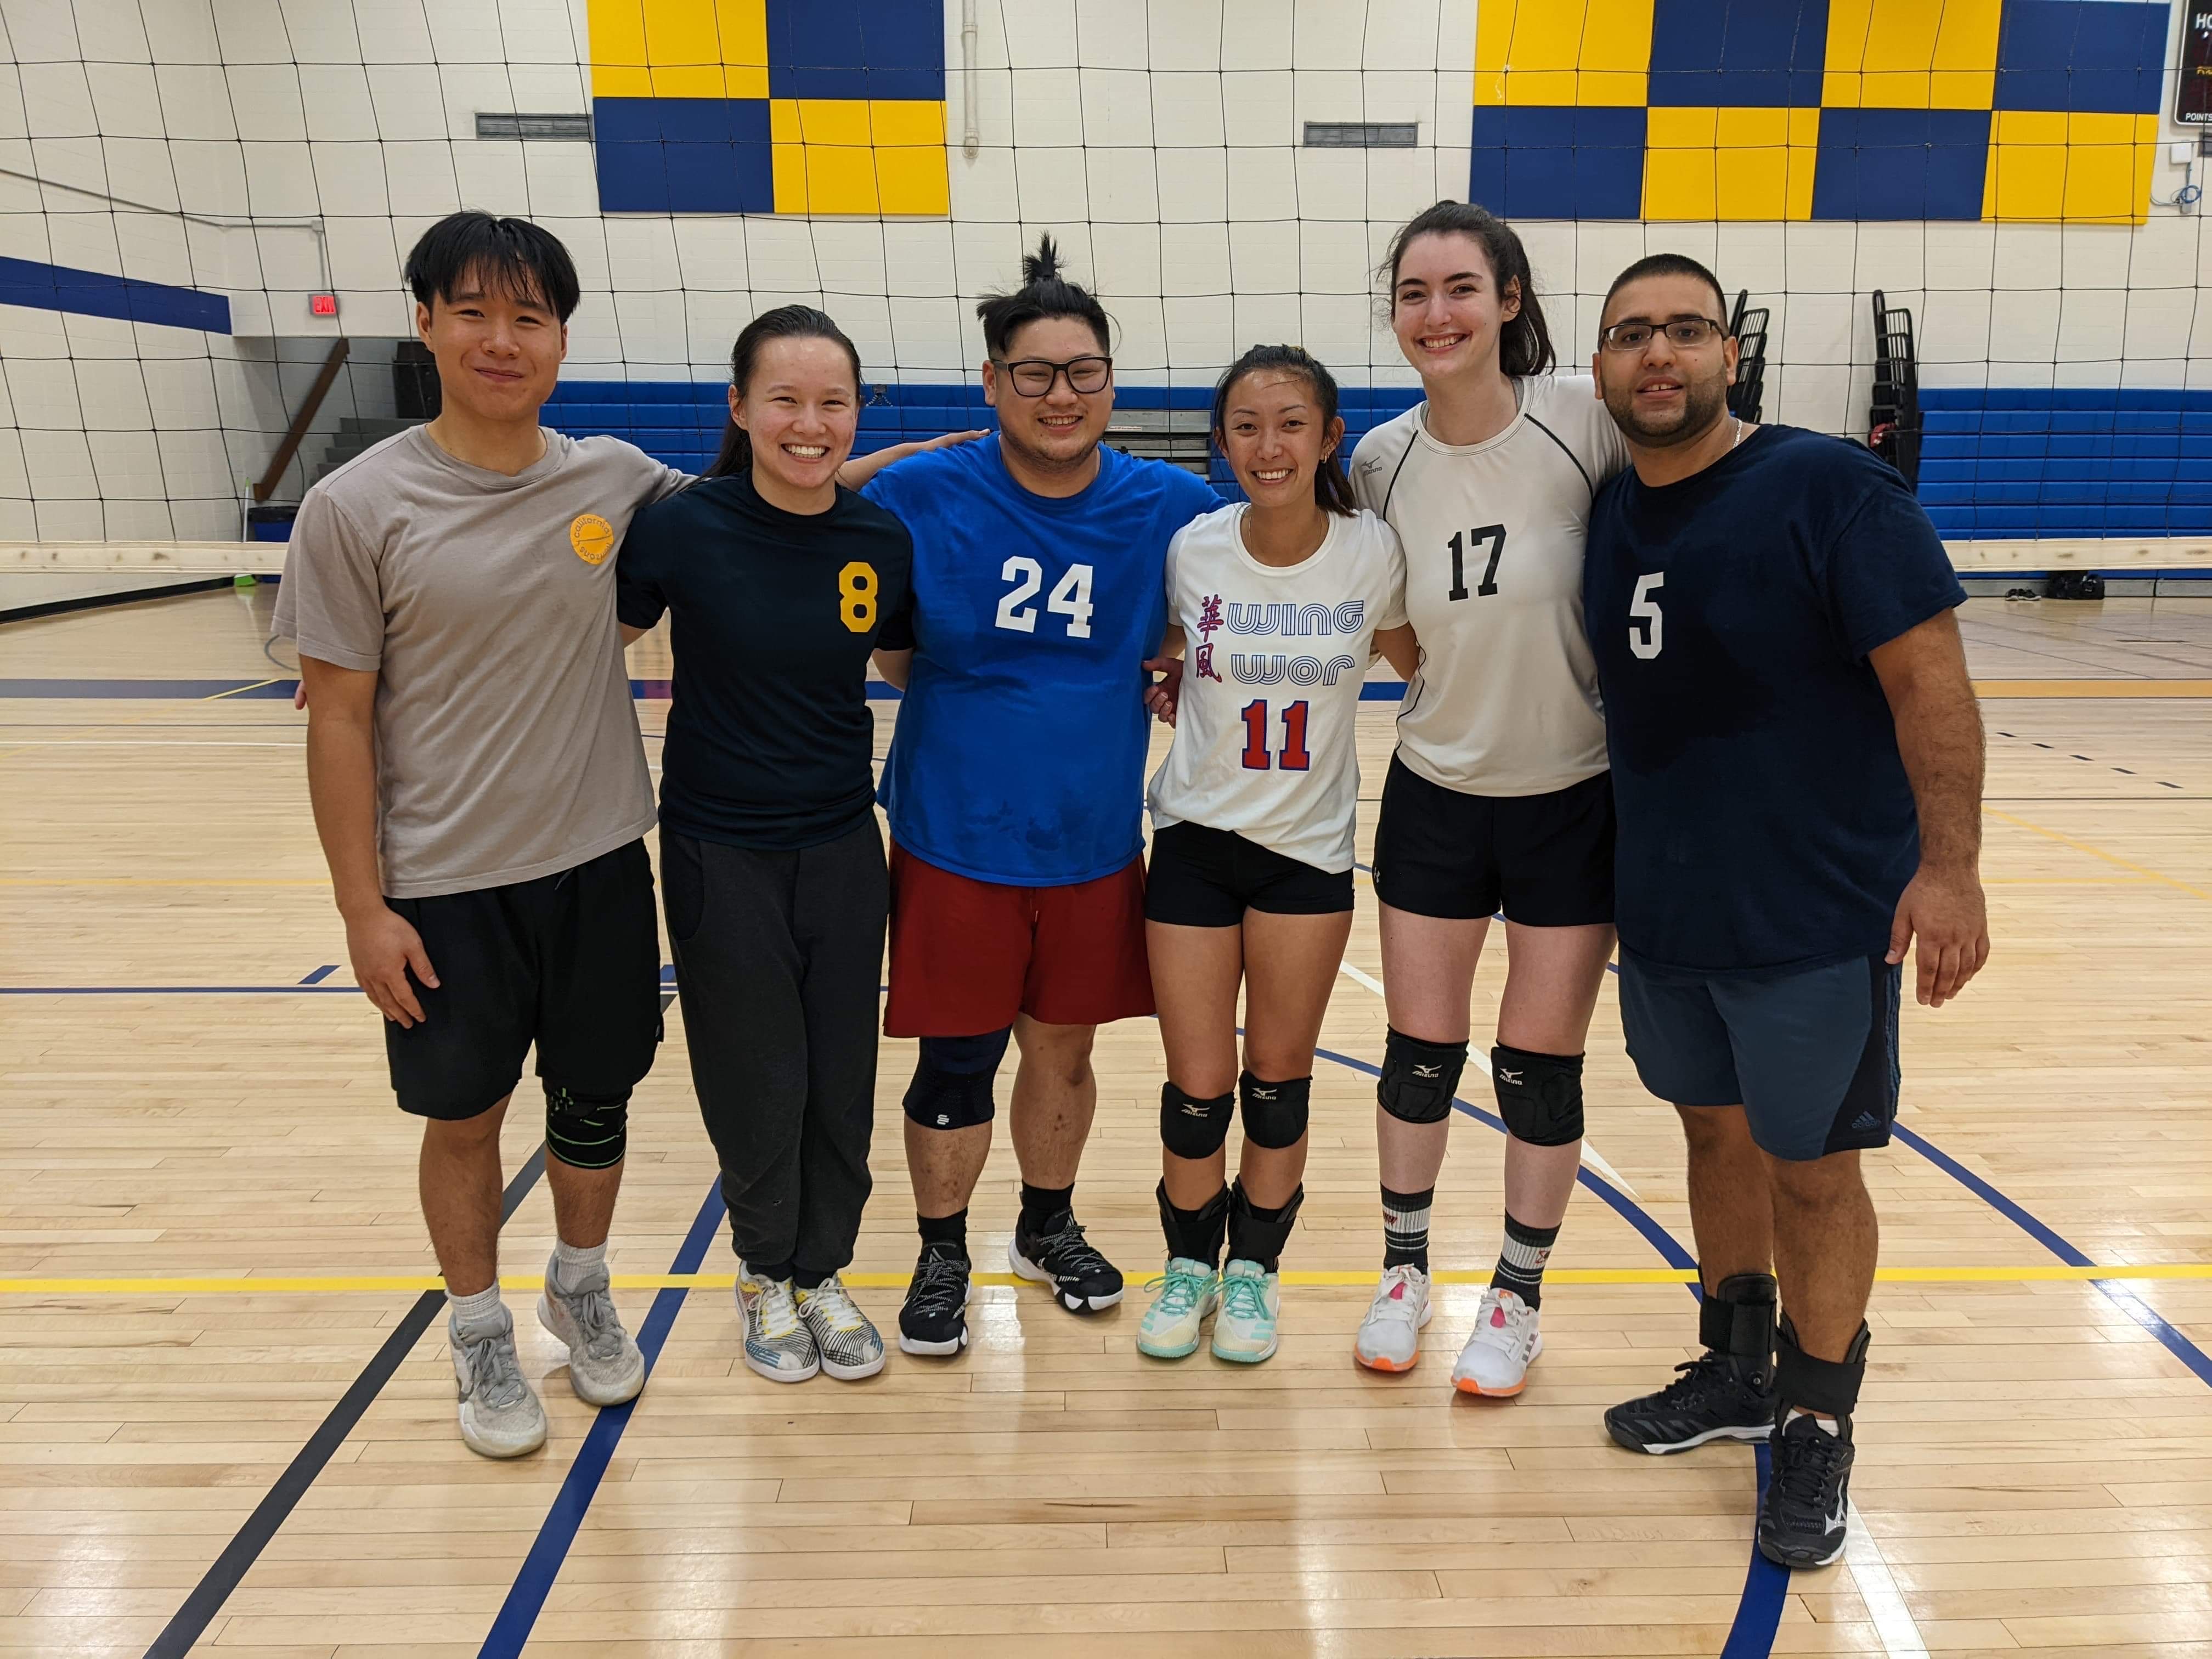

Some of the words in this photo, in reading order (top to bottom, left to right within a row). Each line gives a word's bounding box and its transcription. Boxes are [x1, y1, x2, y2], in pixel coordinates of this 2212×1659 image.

[314, 296, 335, 313] EXIT
[839, 562, 878, 633] 8
[995, 556, 1093, 639] 24
[1447, 523, 1506, 601] 17
[1195, 594, 1224, 683] 華風
[1629, 571, 1664, 659] 5
[1241, 698, 1310, 771] 11
